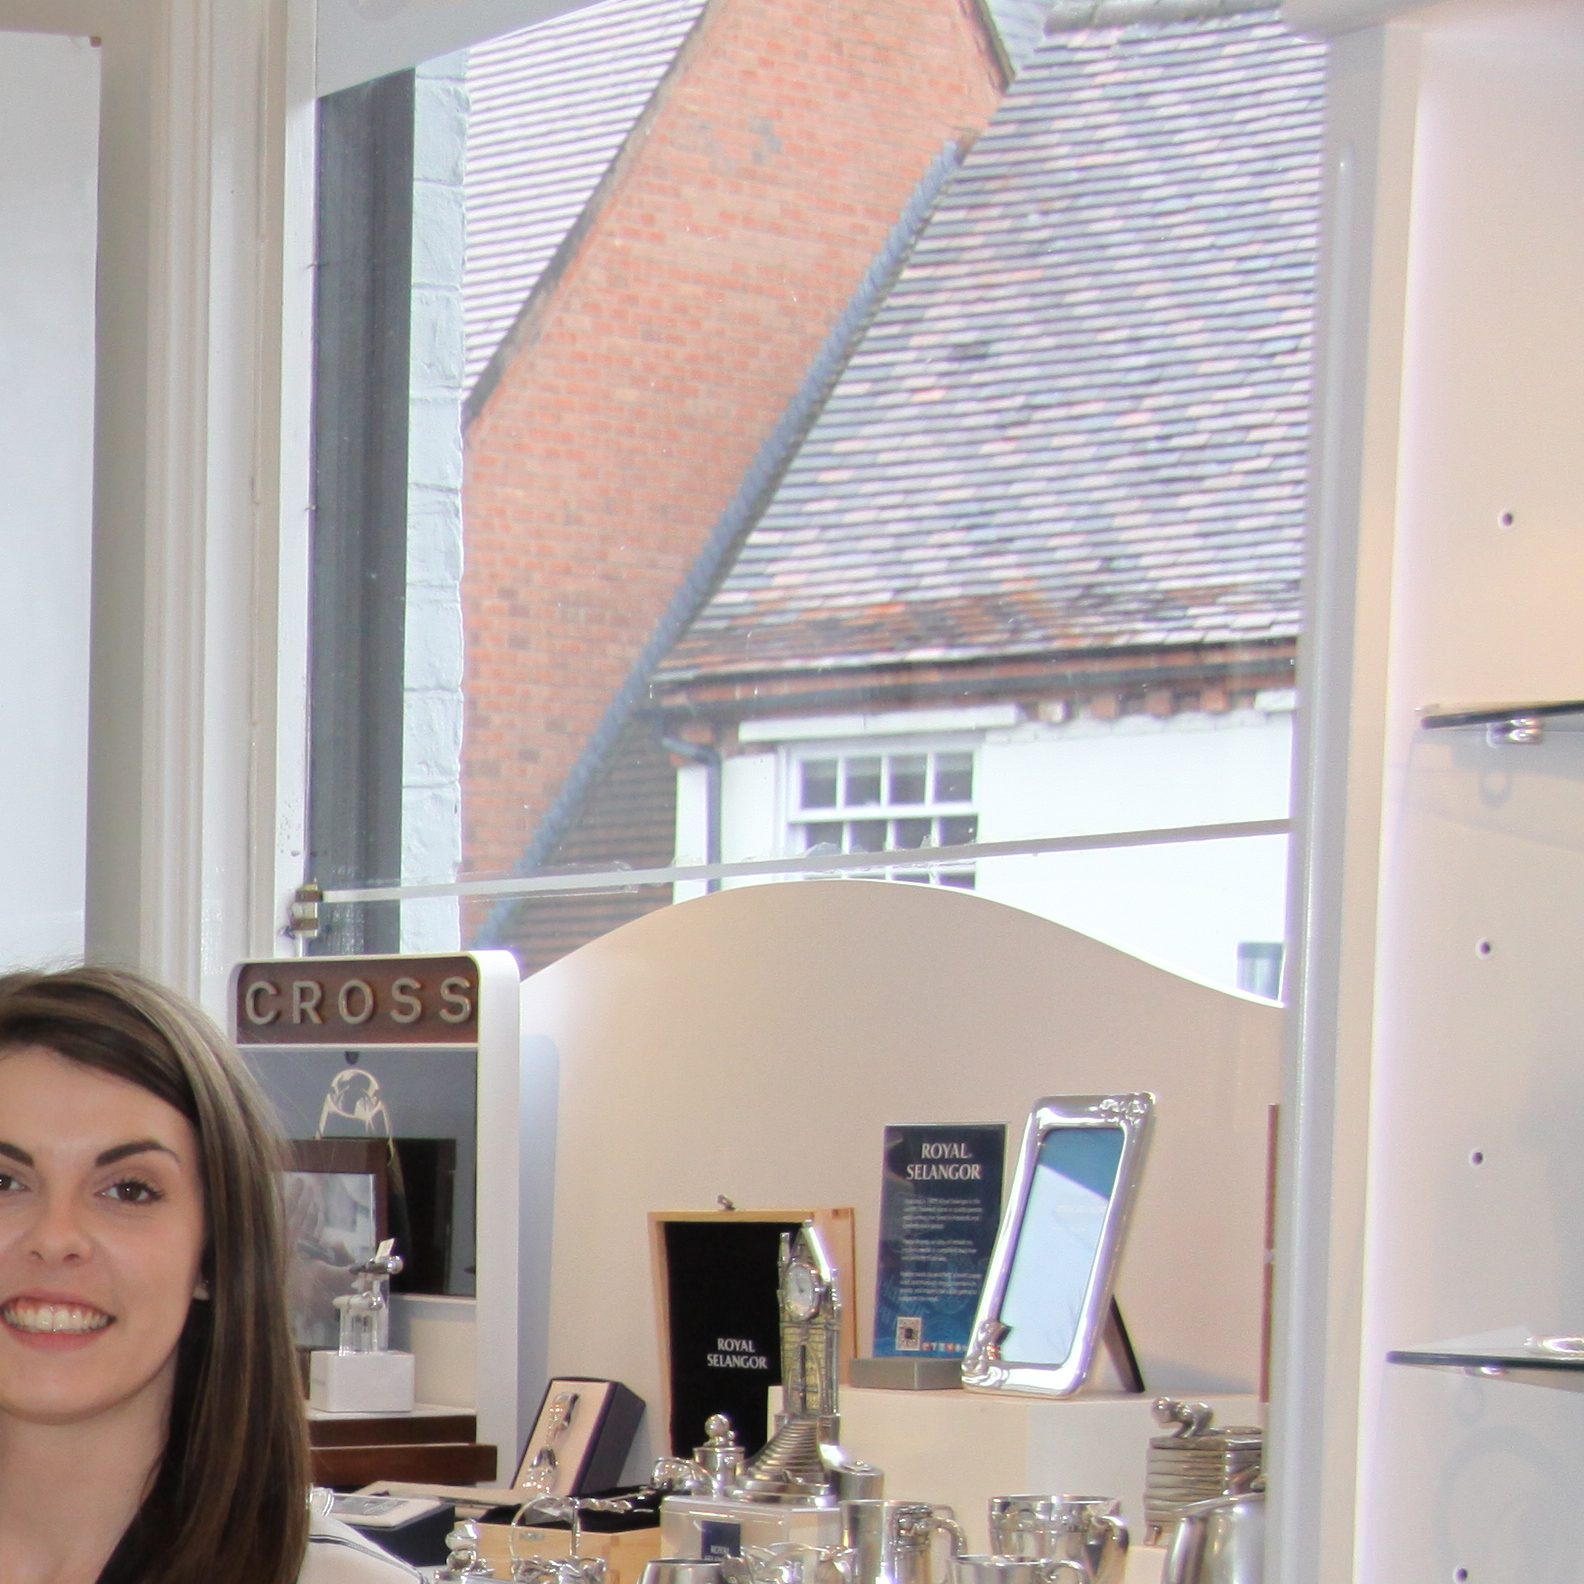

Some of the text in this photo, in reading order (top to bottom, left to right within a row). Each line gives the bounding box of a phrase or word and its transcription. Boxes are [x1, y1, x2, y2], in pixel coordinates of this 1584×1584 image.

[245, 976, 472, 1025] CROSS
[921, 1142, 969, 1160] ROYAL
[906, 1163, 981, 1181] SELANGOR
[717, 1337, 756, 1353] ROYAL
[706, 1353, 769, 1369] SELANGOR
